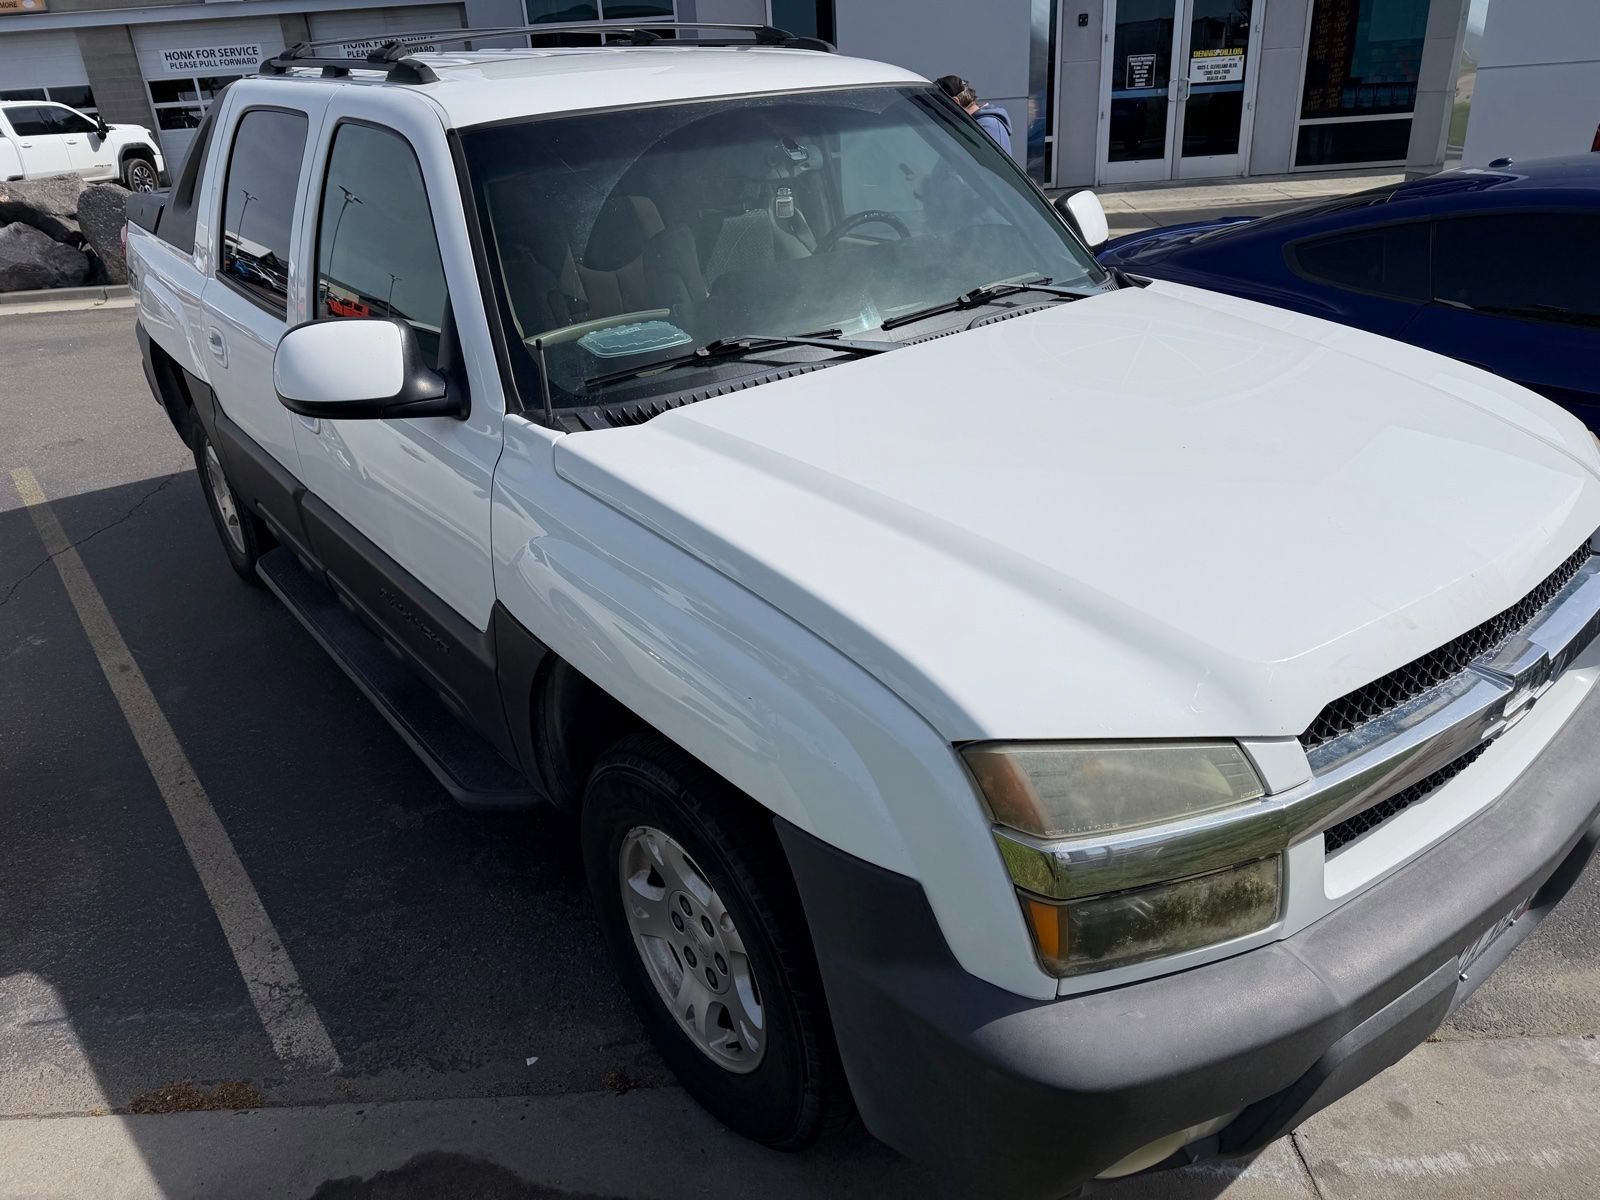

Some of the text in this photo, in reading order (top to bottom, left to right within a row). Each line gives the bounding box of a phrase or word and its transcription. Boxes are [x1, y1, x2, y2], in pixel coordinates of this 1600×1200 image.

[164, 46, 259, 61] HONK FOR SERVICE
[347, 49, 373, 58] PLEAS
[1193, 47, 1243, 58] DENNIS DILLON
[170, 57, 258, 70] PLEASE PULL FORWARD
